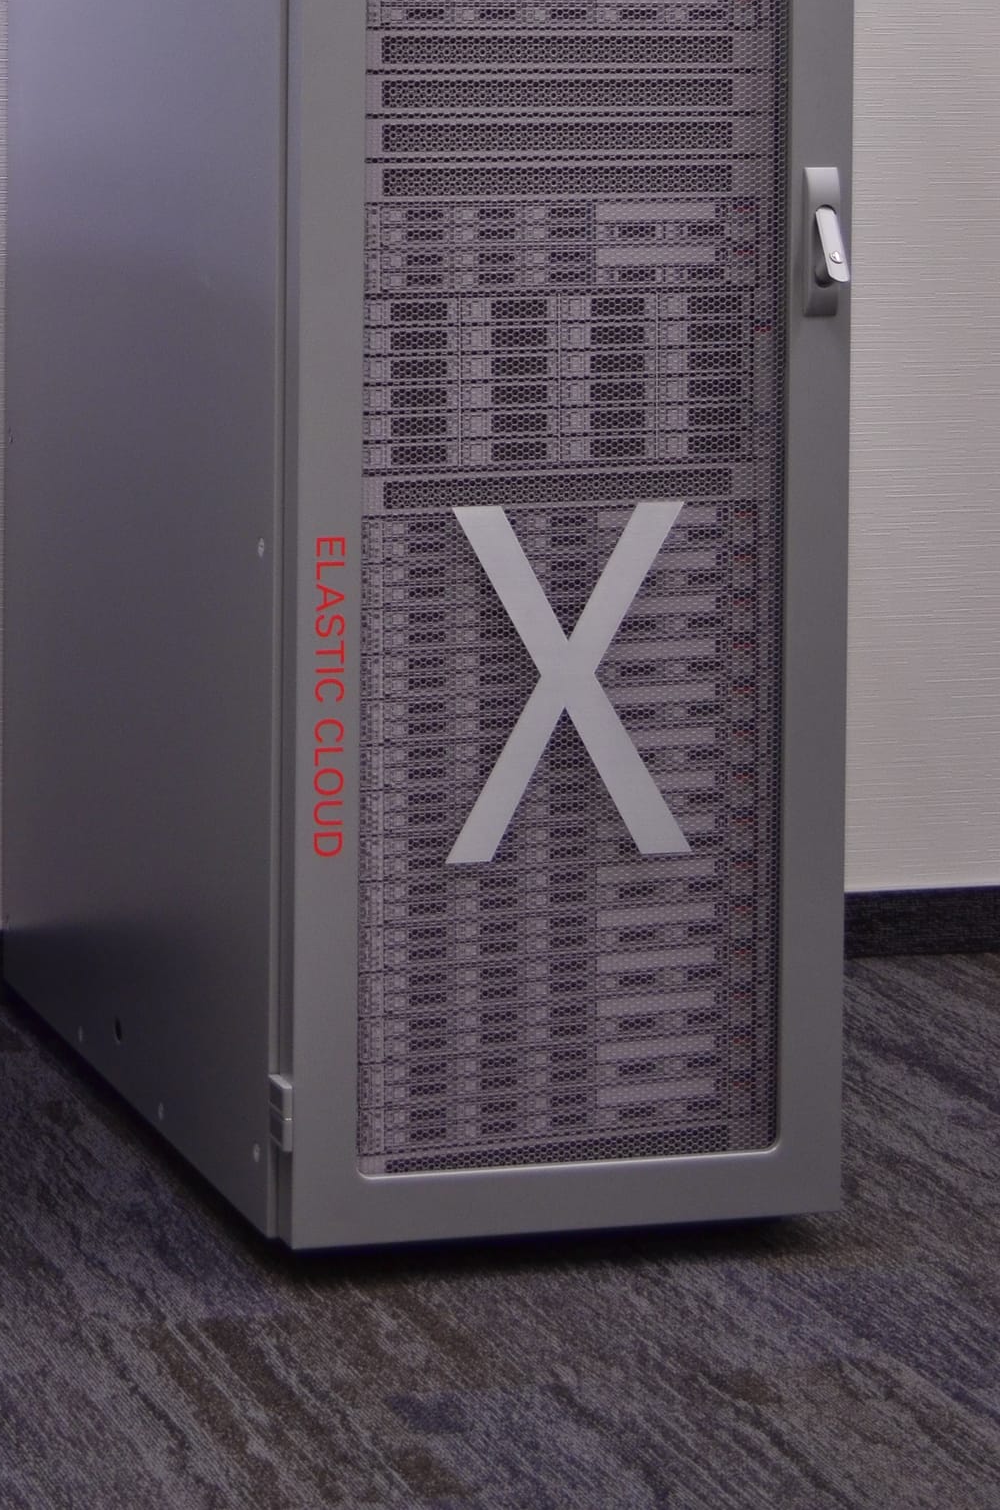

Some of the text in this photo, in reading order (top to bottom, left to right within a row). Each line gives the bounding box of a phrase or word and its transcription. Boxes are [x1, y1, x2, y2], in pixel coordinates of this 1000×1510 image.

[312, 535, 348, 859] ELASTIC CLOUD
[445, 501, 693, 864] X
